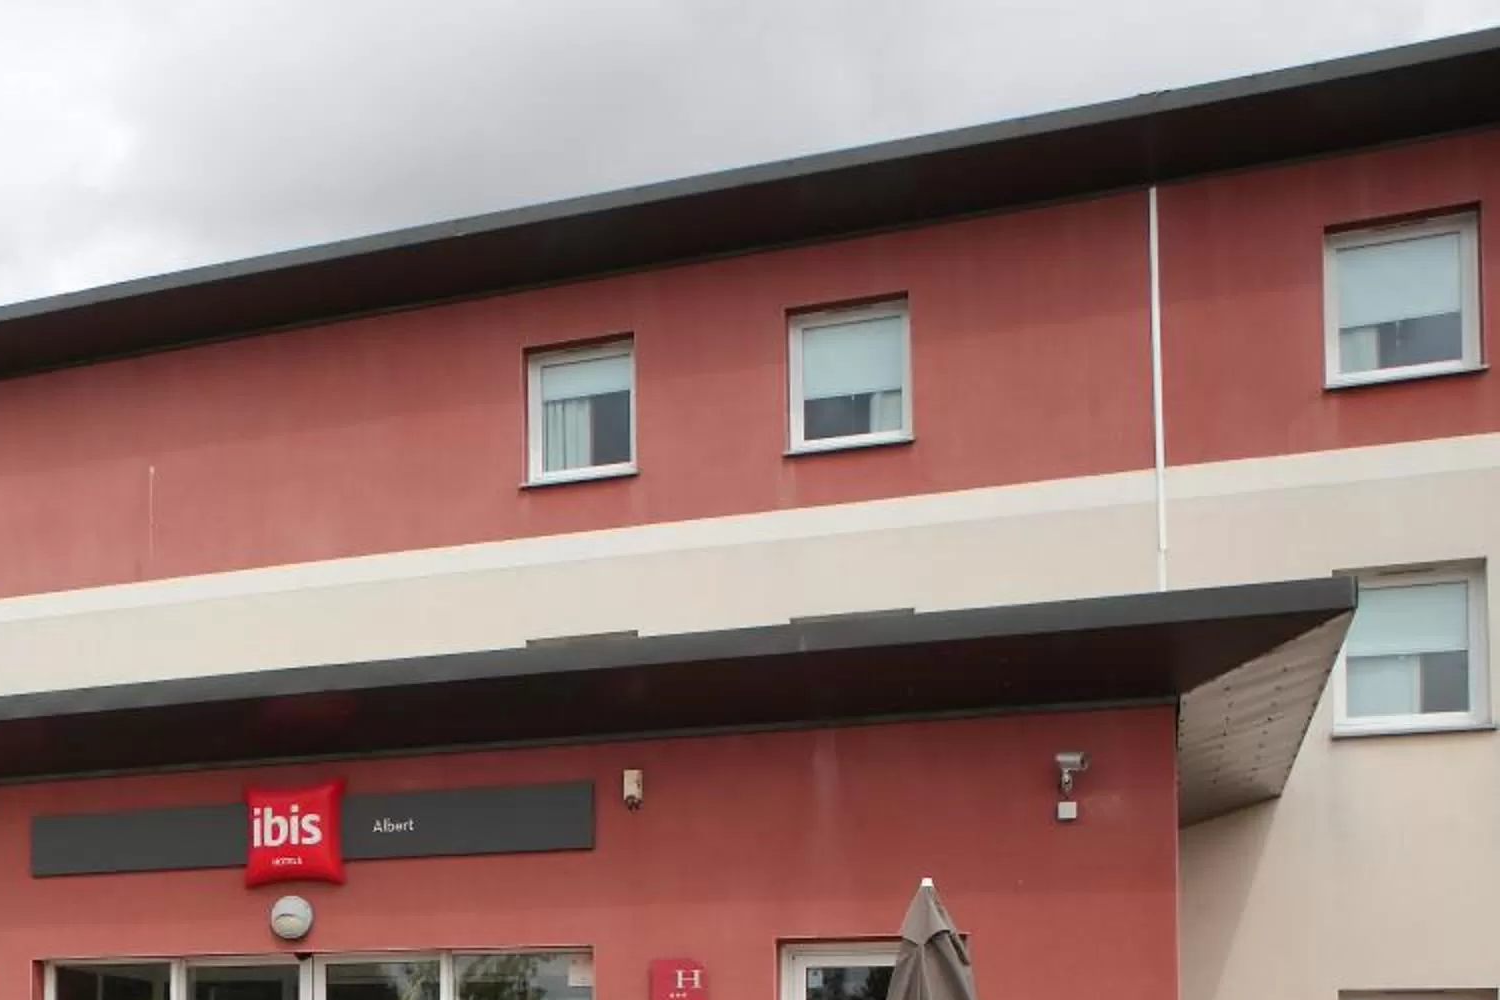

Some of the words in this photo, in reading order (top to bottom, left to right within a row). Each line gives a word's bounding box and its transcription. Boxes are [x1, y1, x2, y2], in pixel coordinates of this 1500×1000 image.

[253, 804, 322, 848] ibis
[372, 818, 415, 833] Albert
[676, 969, 702, 989] H
